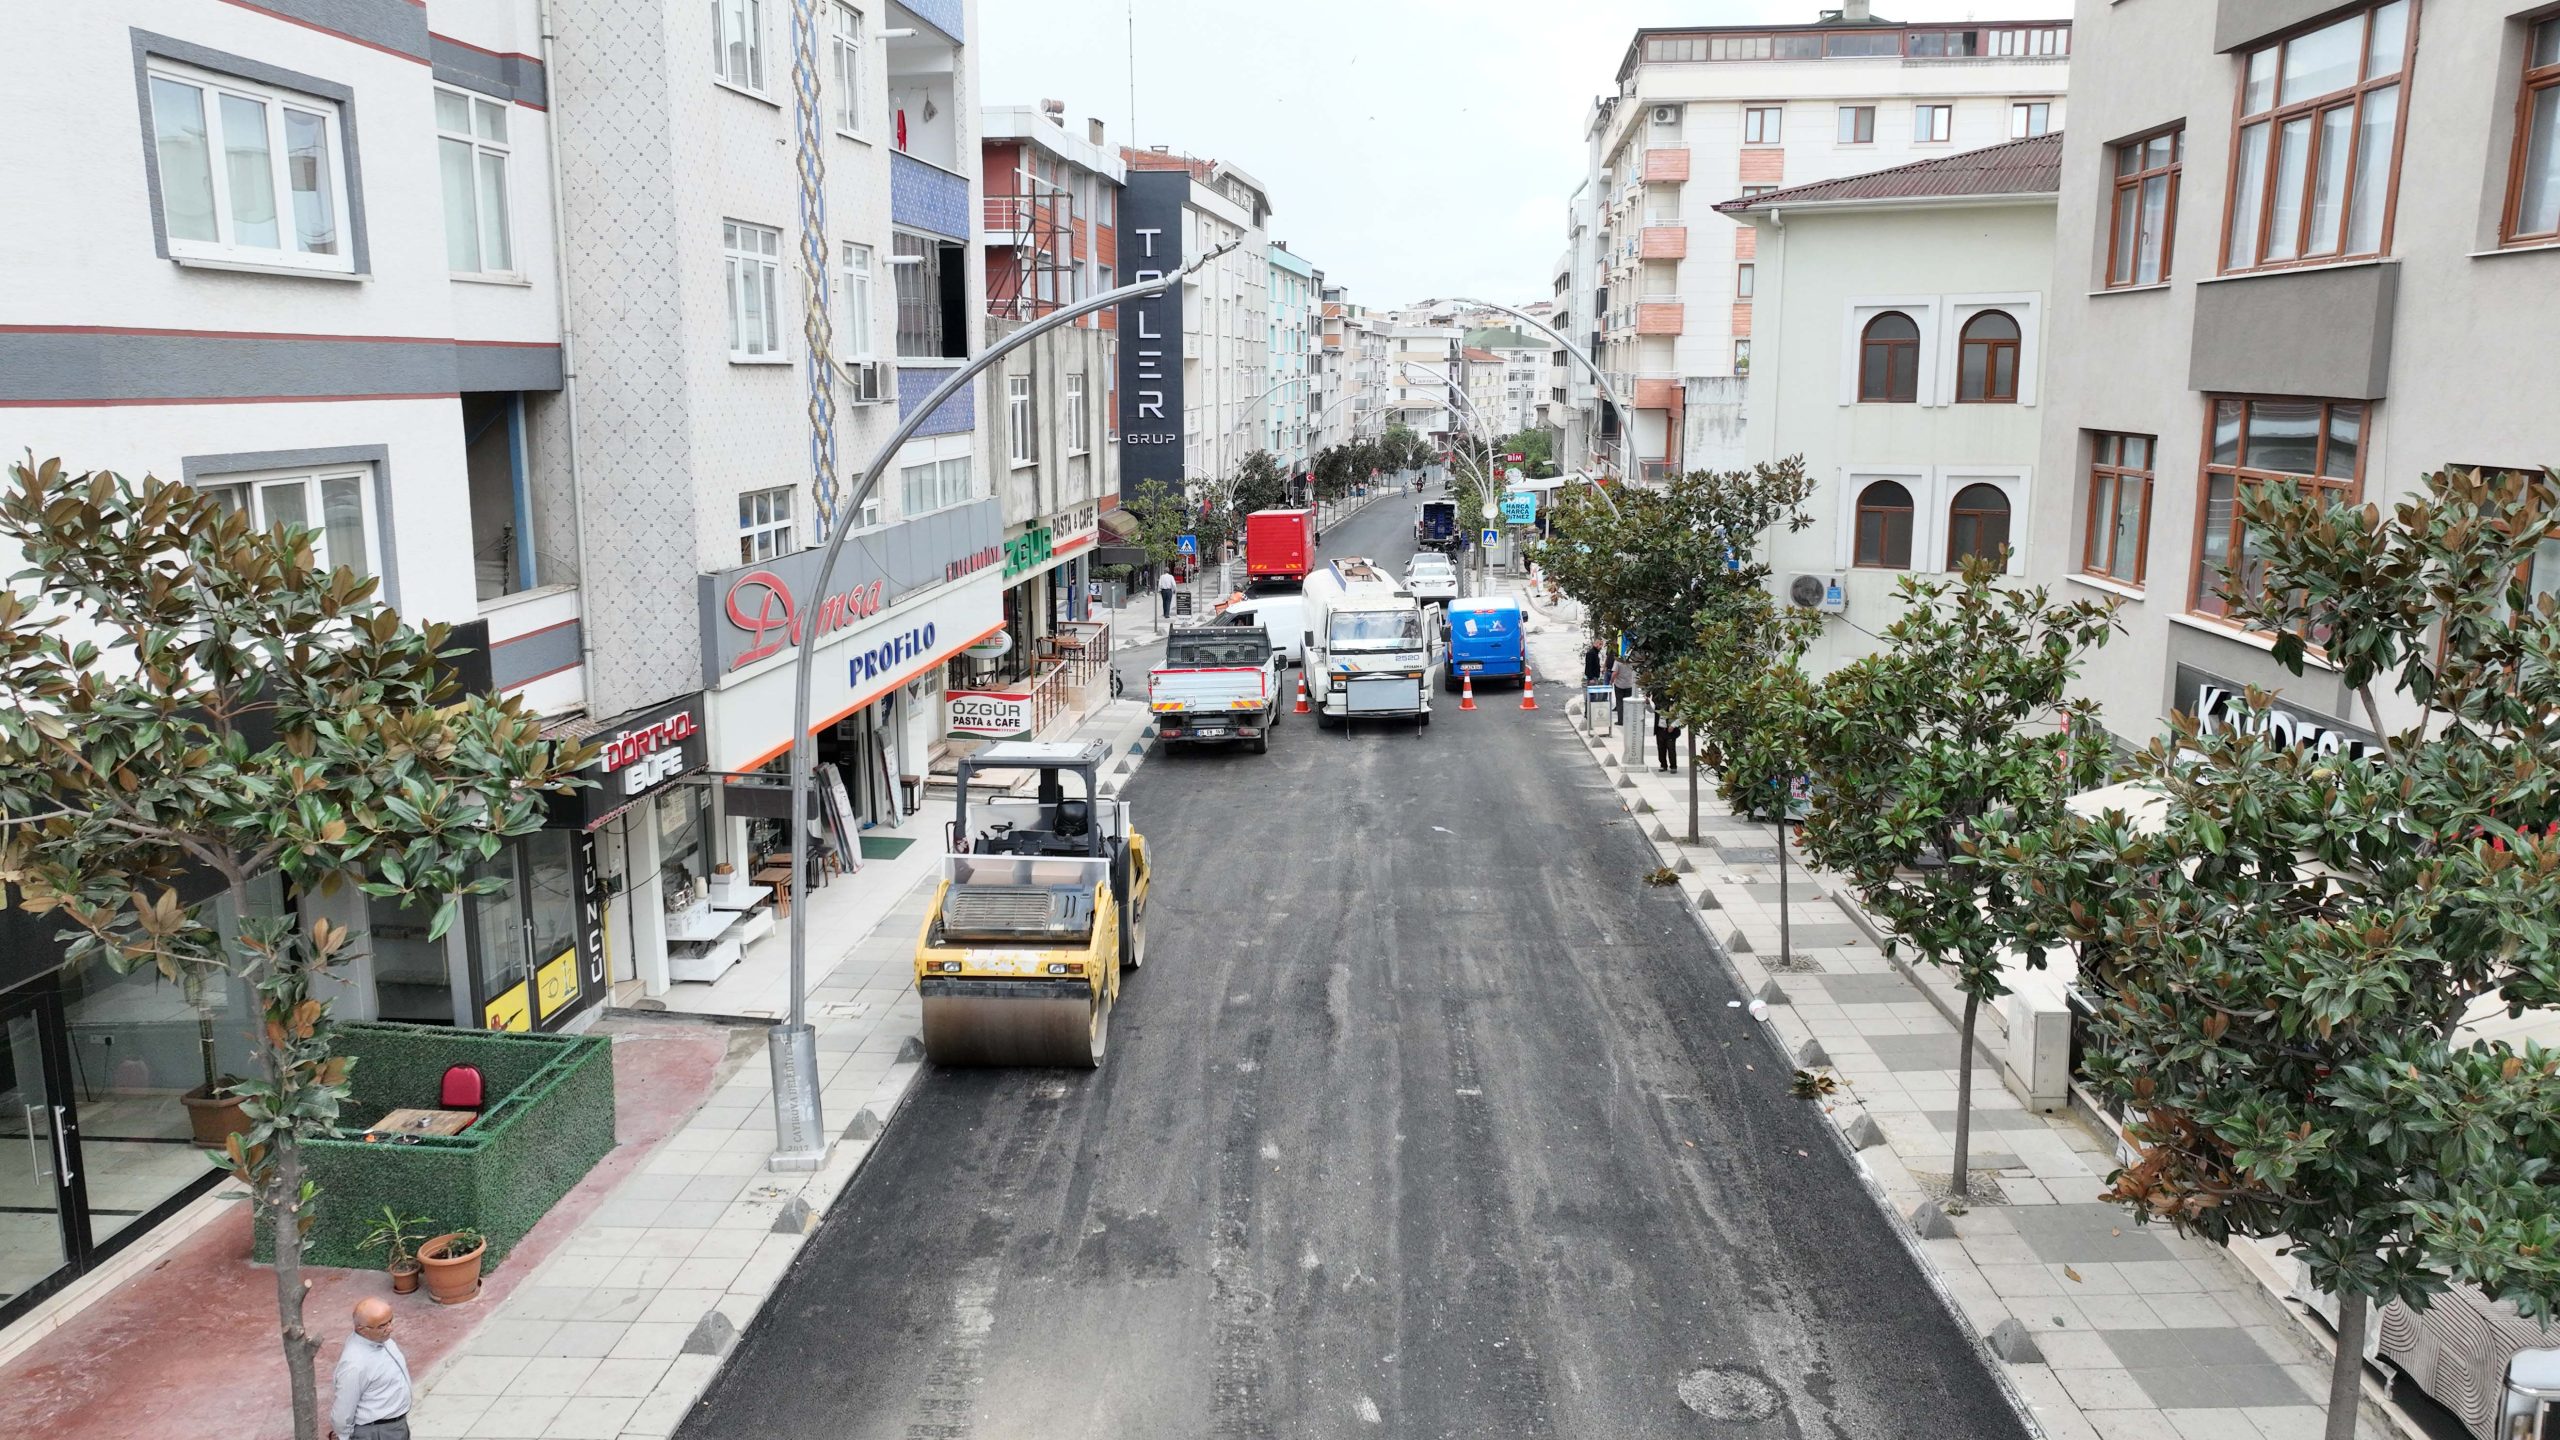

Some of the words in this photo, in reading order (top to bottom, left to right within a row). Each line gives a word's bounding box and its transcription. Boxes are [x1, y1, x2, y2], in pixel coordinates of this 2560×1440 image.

[1127, 434, 1176, 444] GRUP
[1052, 513, 1072, 541] PASTA
[1079, 506, 1093, 531] CAFE
[1003, 519, 1053, 579] ZGÜR
[952, 699, 1021, 717] ÖZGÜR
[953, 716, 984, 726] PASTA
[986, 719, 992, 727] &
[995, 718, 1021, 728] CAFE
[601, 710, 699, 773] DÖRTYOL
[624, 746, 683, 795] BÜFE
[582, 832, 603, 983] TÜNCÜ
